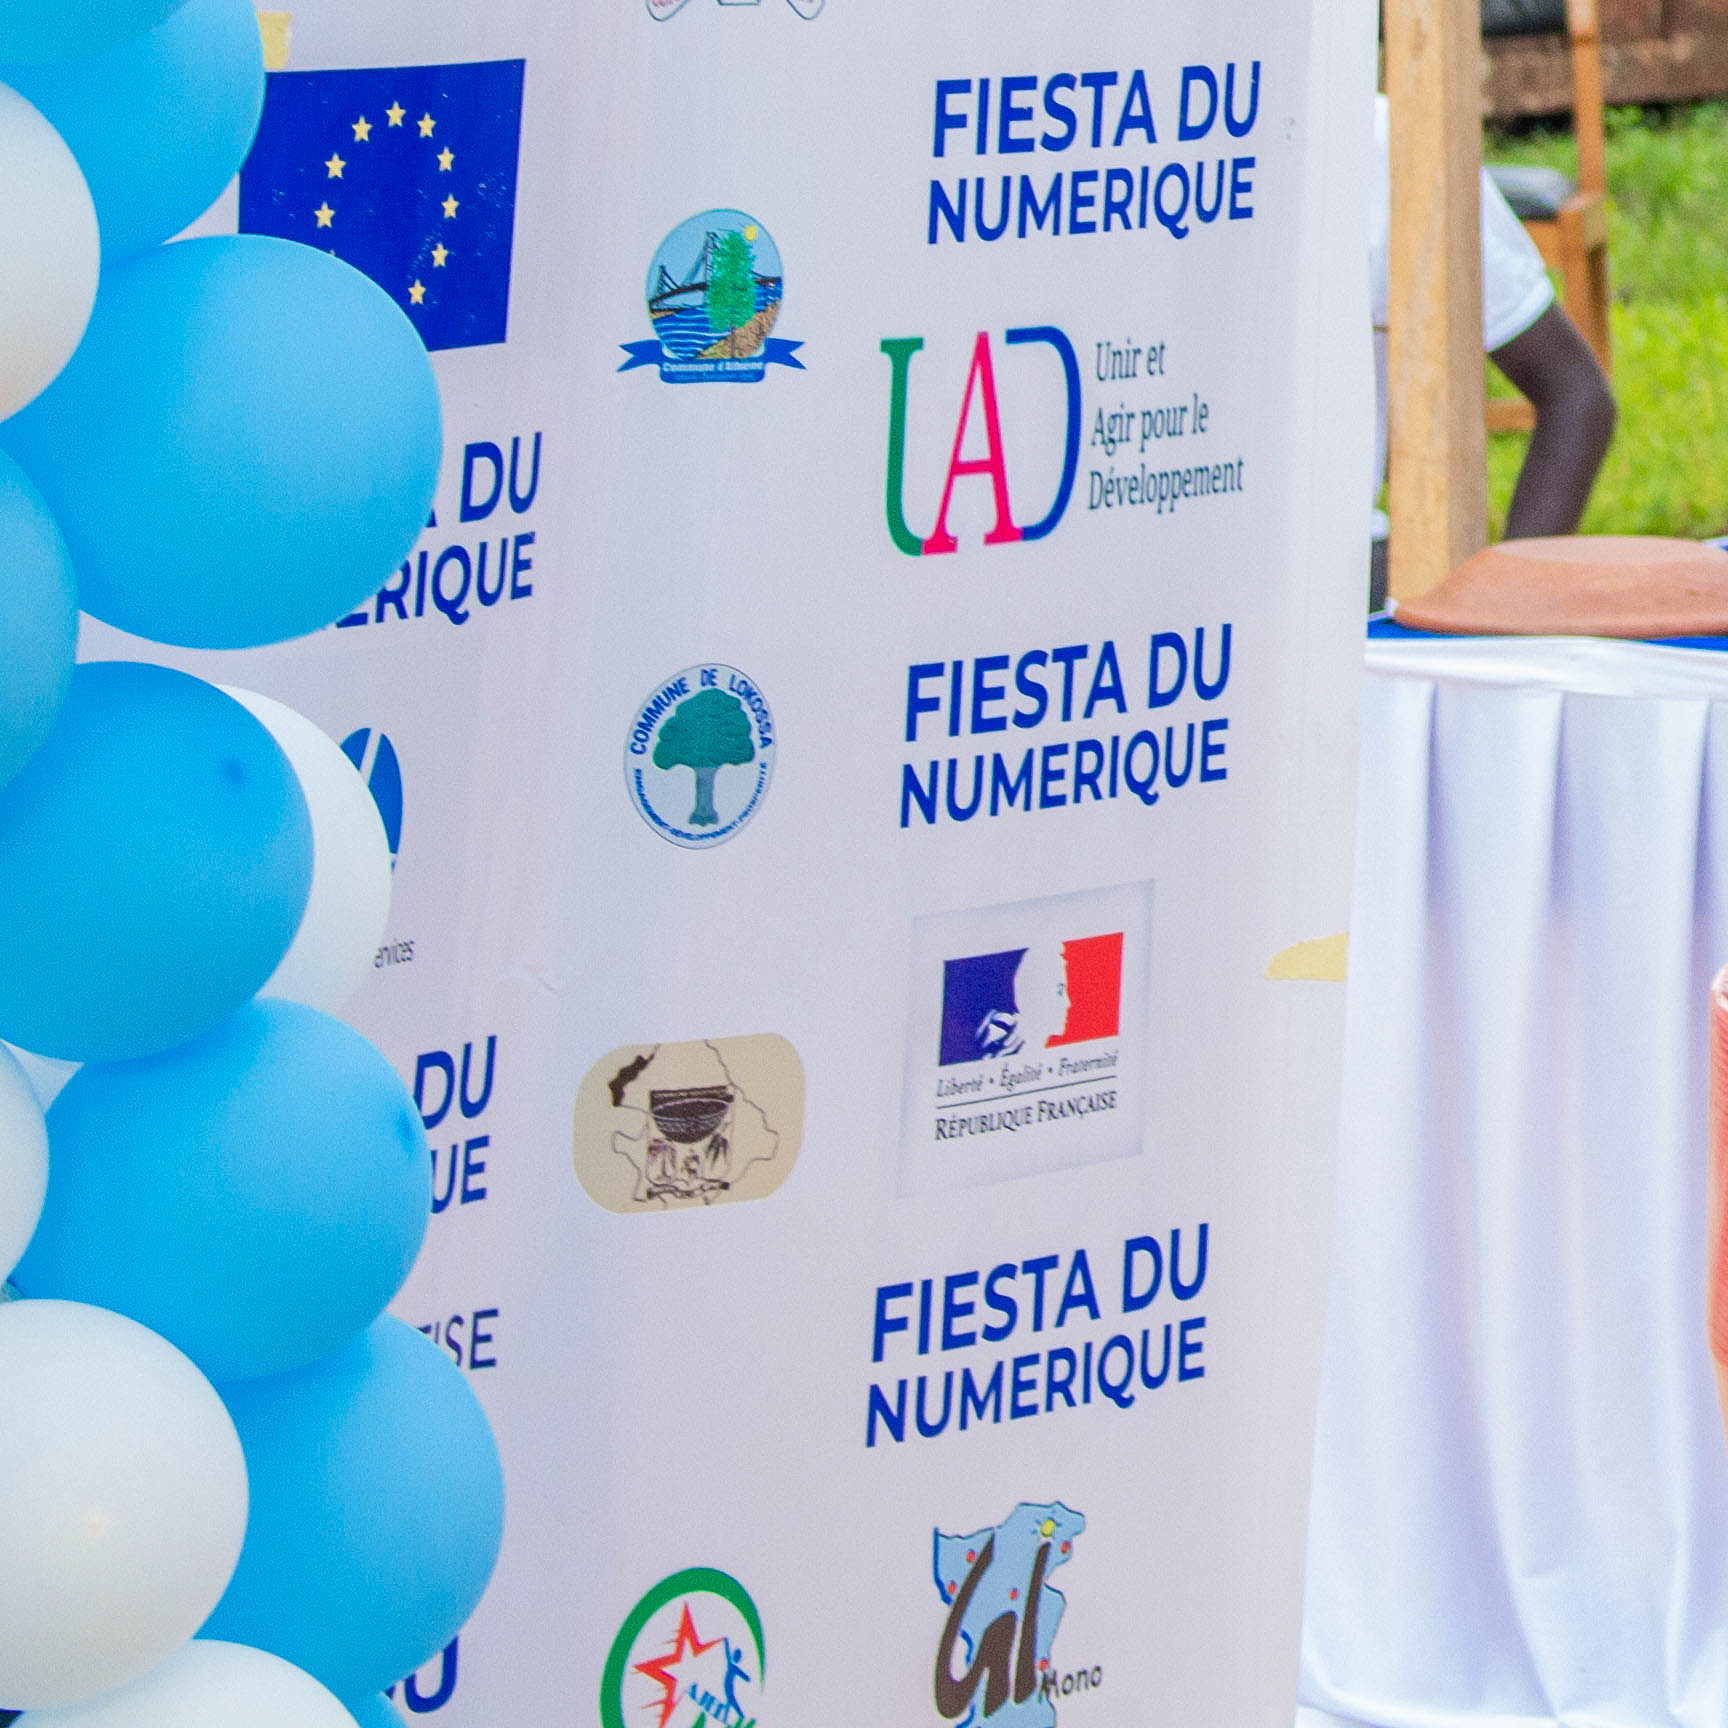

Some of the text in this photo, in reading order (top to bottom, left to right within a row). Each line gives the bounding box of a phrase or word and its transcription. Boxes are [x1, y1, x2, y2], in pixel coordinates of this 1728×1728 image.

[933, 60, 1262, 159] FIESTA DU
[926, 156, 1256, 246] NUMERIQUE
[1096, 338, 1165, 381] Unir et
[880, 325, 1082, 557] UAD
[1090, 392, 1209, 457] Agir pour le
[458, 431, 543, 523] DU
[1088, 458, 1244, 515] Développement
[630, 668, 773, 755] COMMUNE DE LOKOSSA
[905, 623, 1232, 743] FIESTA DU
[900, 718, 1229, 829] NUMERIQUE
[413, 1035, 497, 1130] DU
[935, 1090, 1117, 1141] RÉPUBLIQUE FRANÇAISE
[936, 1074, 984, 1097] Liberté
[872, 1222, 1210, 1364] FIESTA DU
[865, 1316, 1208, 1448] NUMERIQUE
[1038, 1665, 1103, 1704] Mono
